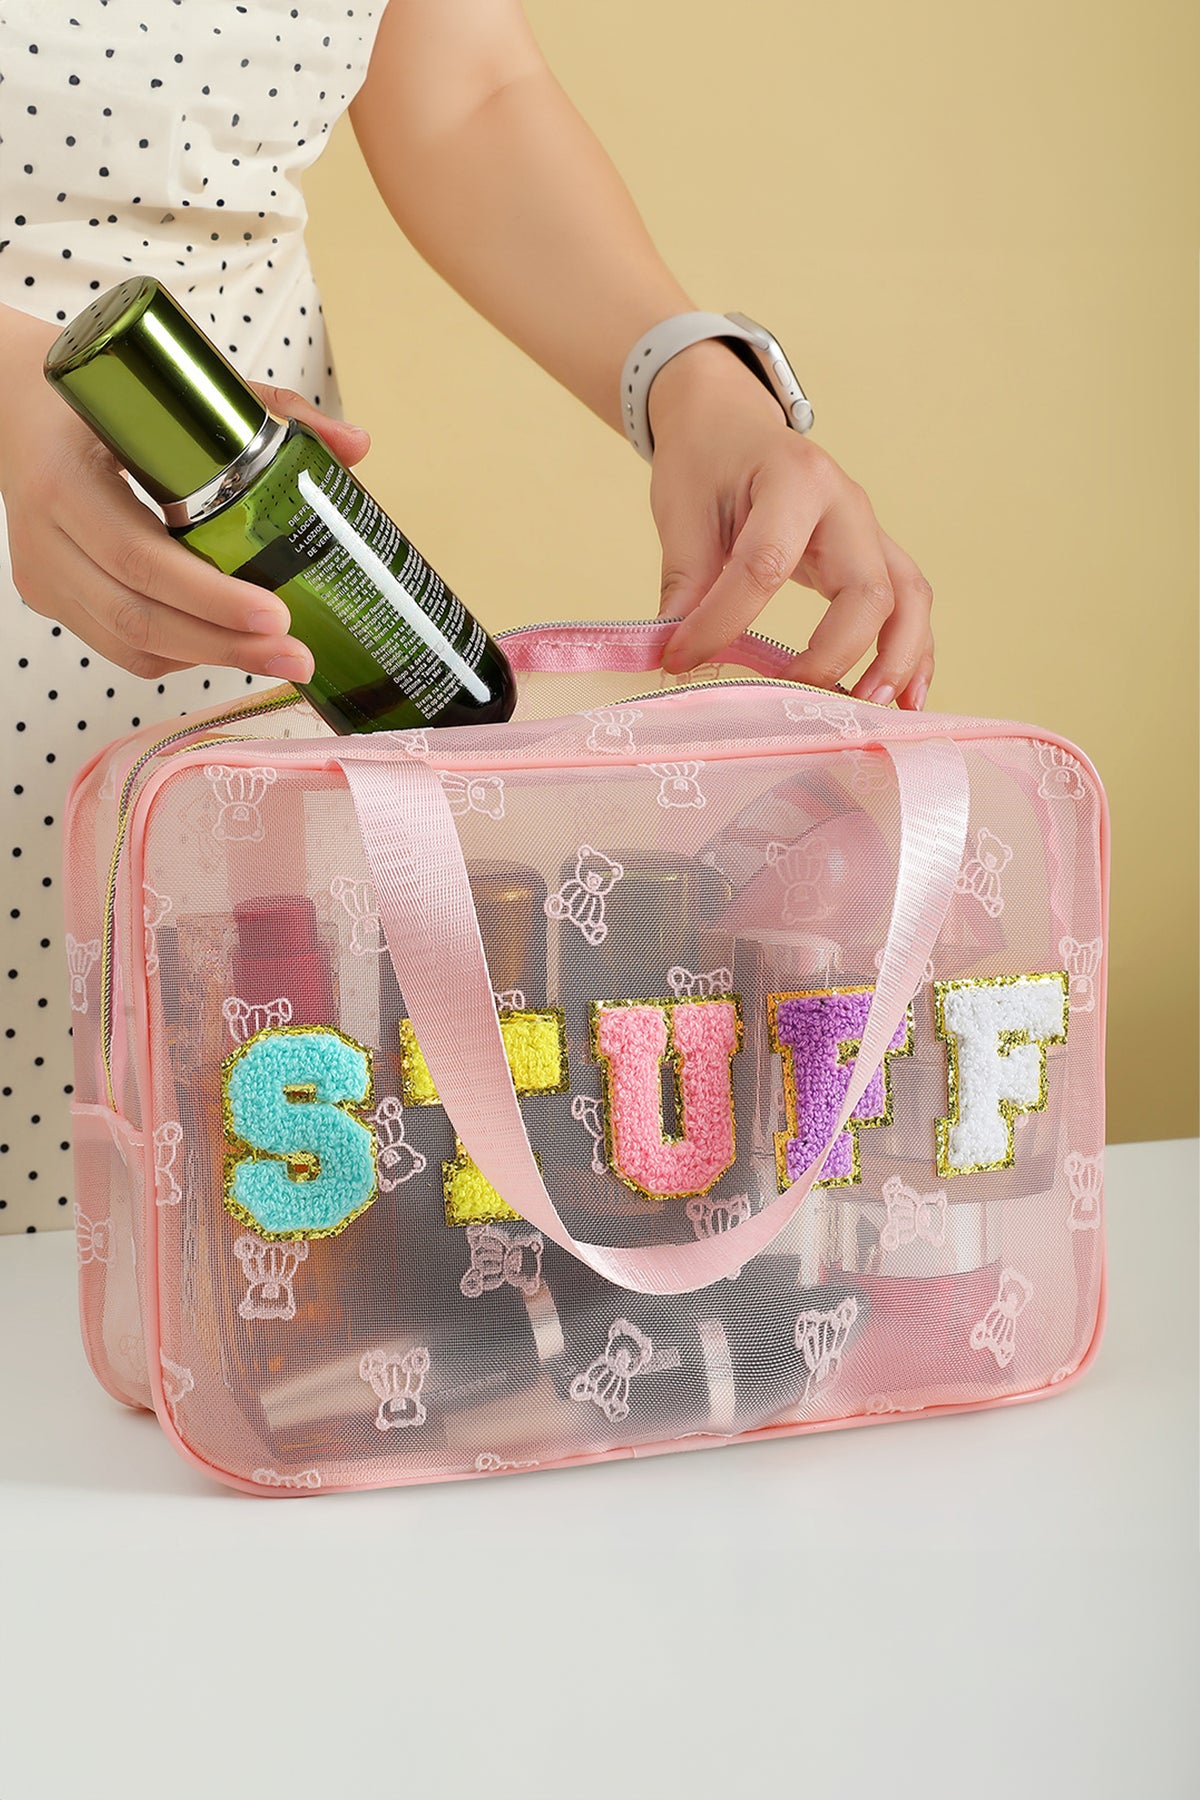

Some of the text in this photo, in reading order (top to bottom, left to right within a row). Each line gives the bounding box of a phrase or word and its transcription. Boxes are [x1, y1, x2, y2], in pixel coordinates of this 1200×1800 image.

[289, 515, 300, 526] DIE
[289, 534, 298, 542] LA
[295, 544, 304, 552] LA
[308, 547, 317, 557] DE
[304, 567, 317, 579] After
